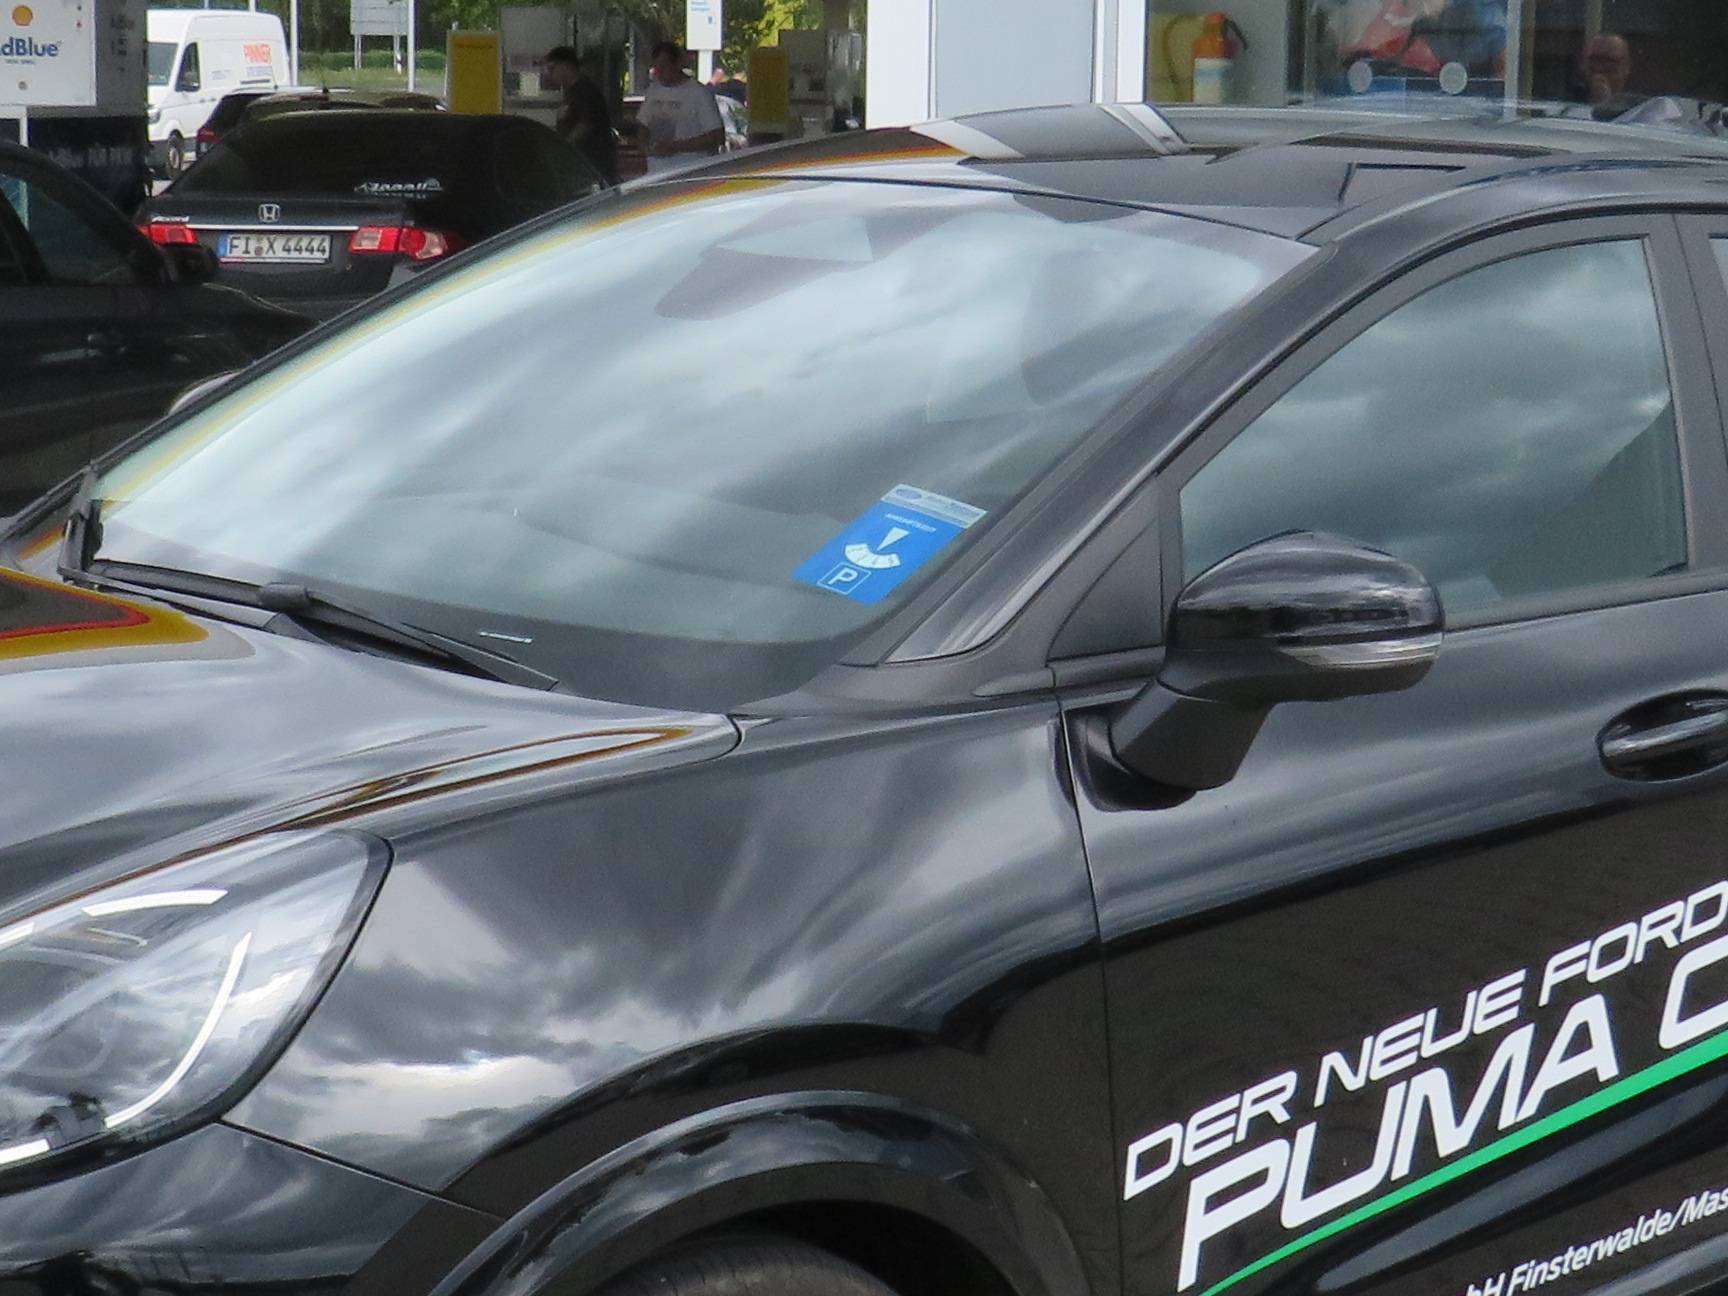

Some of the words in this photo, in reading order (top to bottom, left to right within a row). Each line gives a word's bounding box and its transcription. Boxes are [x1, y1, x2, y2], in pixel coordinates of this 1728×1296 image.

[228, 235, 252, 255] FI
[263, 235, 278, 255] X
[282, 235, 328, 256] 4444
[1123, 1070, 1298, 1201] DER
[1314, 968, 1527, 1108] NEUE
[1177, 993, 1619, 1293] PUMA
